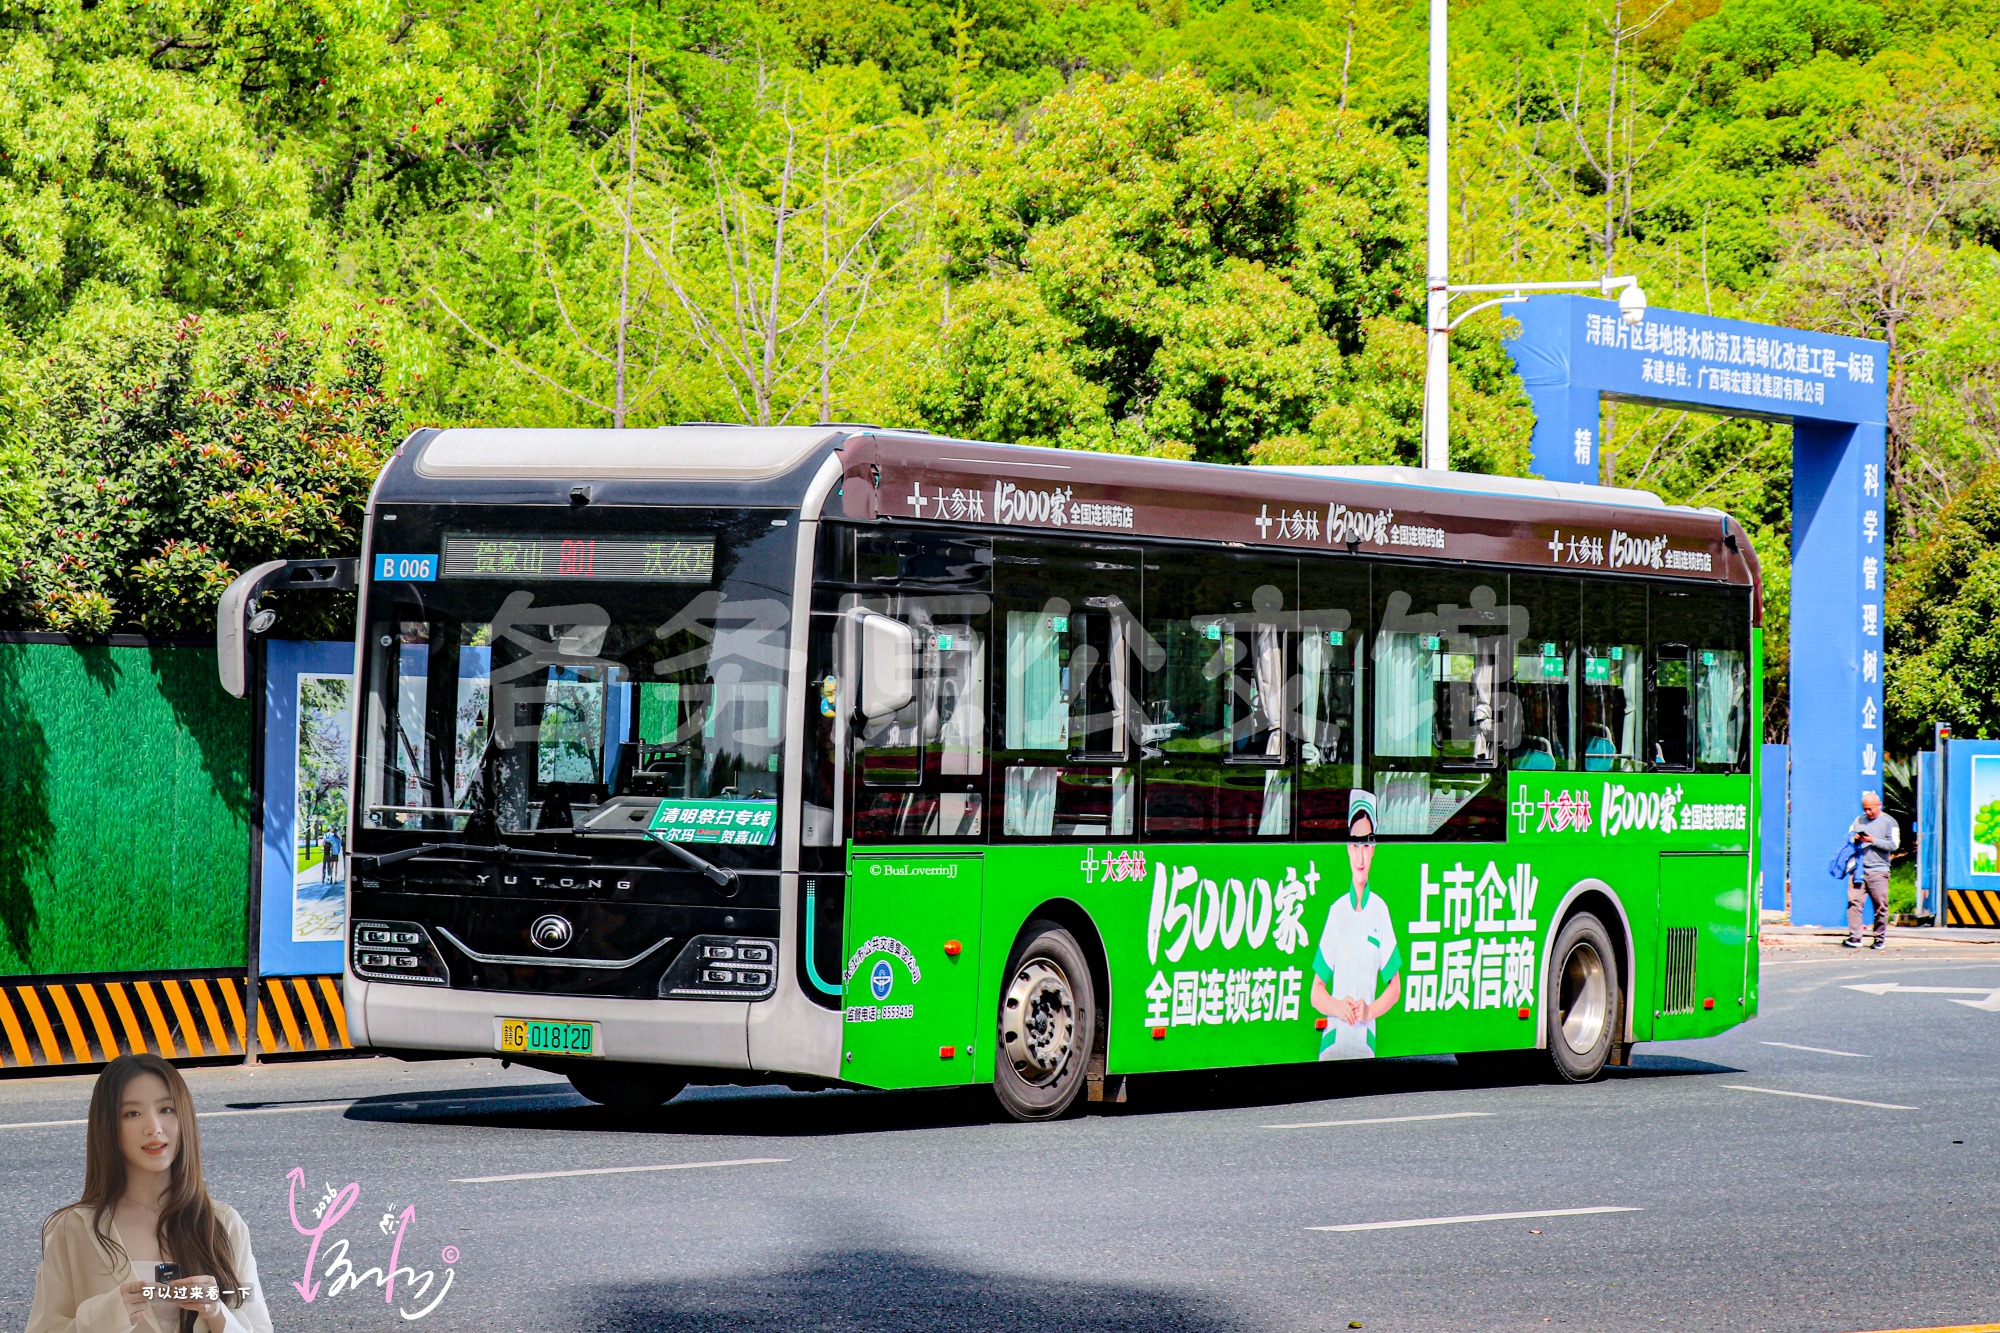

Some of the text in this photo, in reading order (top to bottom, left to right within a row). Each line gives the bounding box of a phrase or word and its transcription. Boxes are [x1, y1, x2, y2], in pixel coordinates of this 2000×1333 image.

[1586, 313, 1875, 384] 浔南片区绿地排水防涝及海绵化改造工程一标段
[932, 487, 985, 522] 大参林
[1070, 502, 1134, 529] 全国连锁药店
[1276, 509, 1320, 541] 大参林
[1390, 524, 1445, 549] 全国连锁药店
[383, 558, 430, 578] B 006
[559, 540, 596, 576] 801
[1566, 535, 1604, 565] 大参林
[1664, 549, 1712, 572] 全国连锁药店
[1861, 463, 1880, 797] 科学管理树企业
[659, 807, 772, 827] 清明祭扫专线
[1537, 789, 1592, 833] 大参林
[1680, 804, 1747, 831] 全国连锁药店
[719, 829, 764, 845] 贺嘉山
[477, 874, 631, 890] YUTONG
[1101, 850, 1147, 882] 大参林
[1408, 860, 1539, 936] 上市企业
[1404, 936, 1535, 1012] 品质信赖
[1144, 966, 1303, 1027] 全国连锁药店
